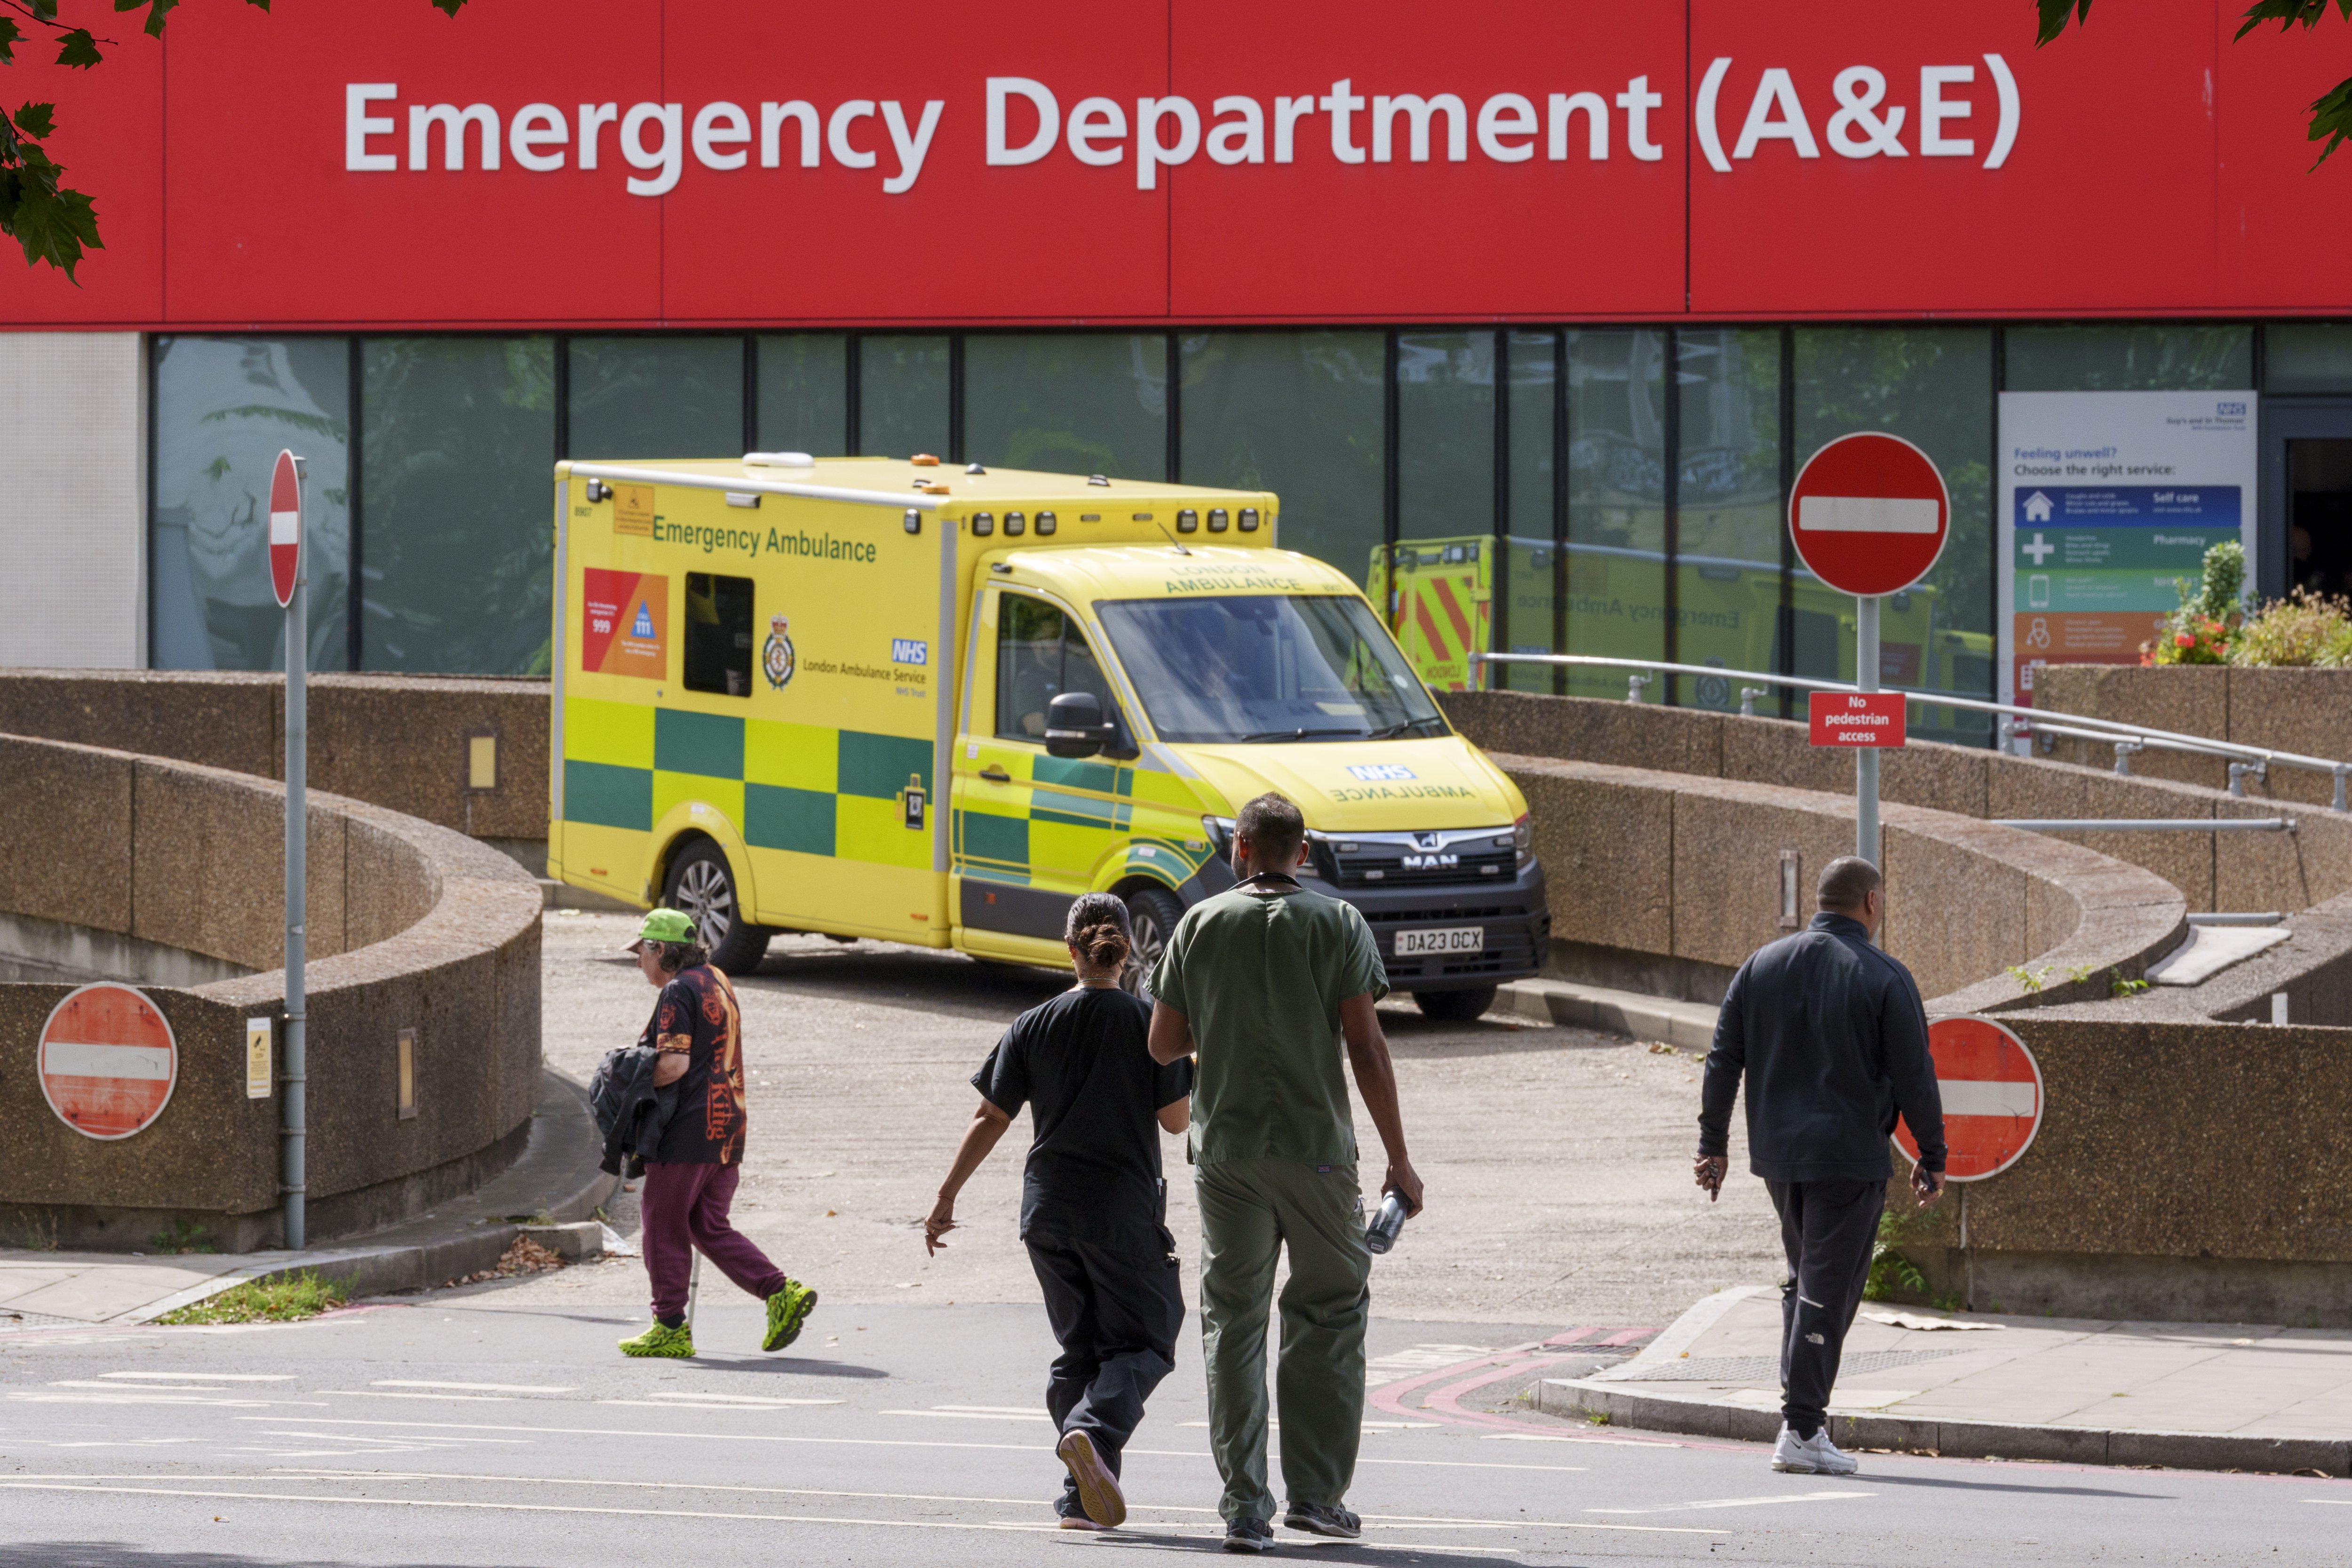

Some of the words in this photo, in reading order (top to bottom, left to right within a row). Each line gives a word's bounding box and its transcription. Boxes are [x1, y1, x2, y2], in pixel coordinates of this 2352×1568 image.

[346, 83, 945, 196] Emergency
[986, 75, 1663, 190] Department
[1695, 53, 2021, 172] (A&E)
[2014, 447, 2061, 462] Feeling
[2065, 446, 2117, 459] unwell?
[2014, 463, 2062, 476] Choose
[2066, 463, 2087, 476] the
[2091, 463, 2123, 478] right
[2153, 492, 2174, 503] Self
[2176, 494, 2200, 503] care
[653, 516, 761, 557] Emergency
[766, 527, 876, 563] Ambulance
[2153, 534, 2207, 548] Pharmacy
[1170, 565, 1268, 576] LONDON
[1165, 577, 1305, 593] AMBULANCE
[592, 619, 611, 634] 999
[636, 620, 651, 635] 111
[893, 639, 926, 665] NHS
[803, 659, 838, 674] London
[840, 663, 891, 681] Ambulance
[893, 669, 926, 684] Service
[1848, 695, 1867, 708] No
[1825, 712, 1890, 727] pedestrian
[1838, 731, 1876, 742] access
[1348, 764, 1416, 780] NHS
[1401, 854, 1459, 870] MAN
[1407, 932, 1446, 951] DA23
[706, 1082, 729, 1141] King
